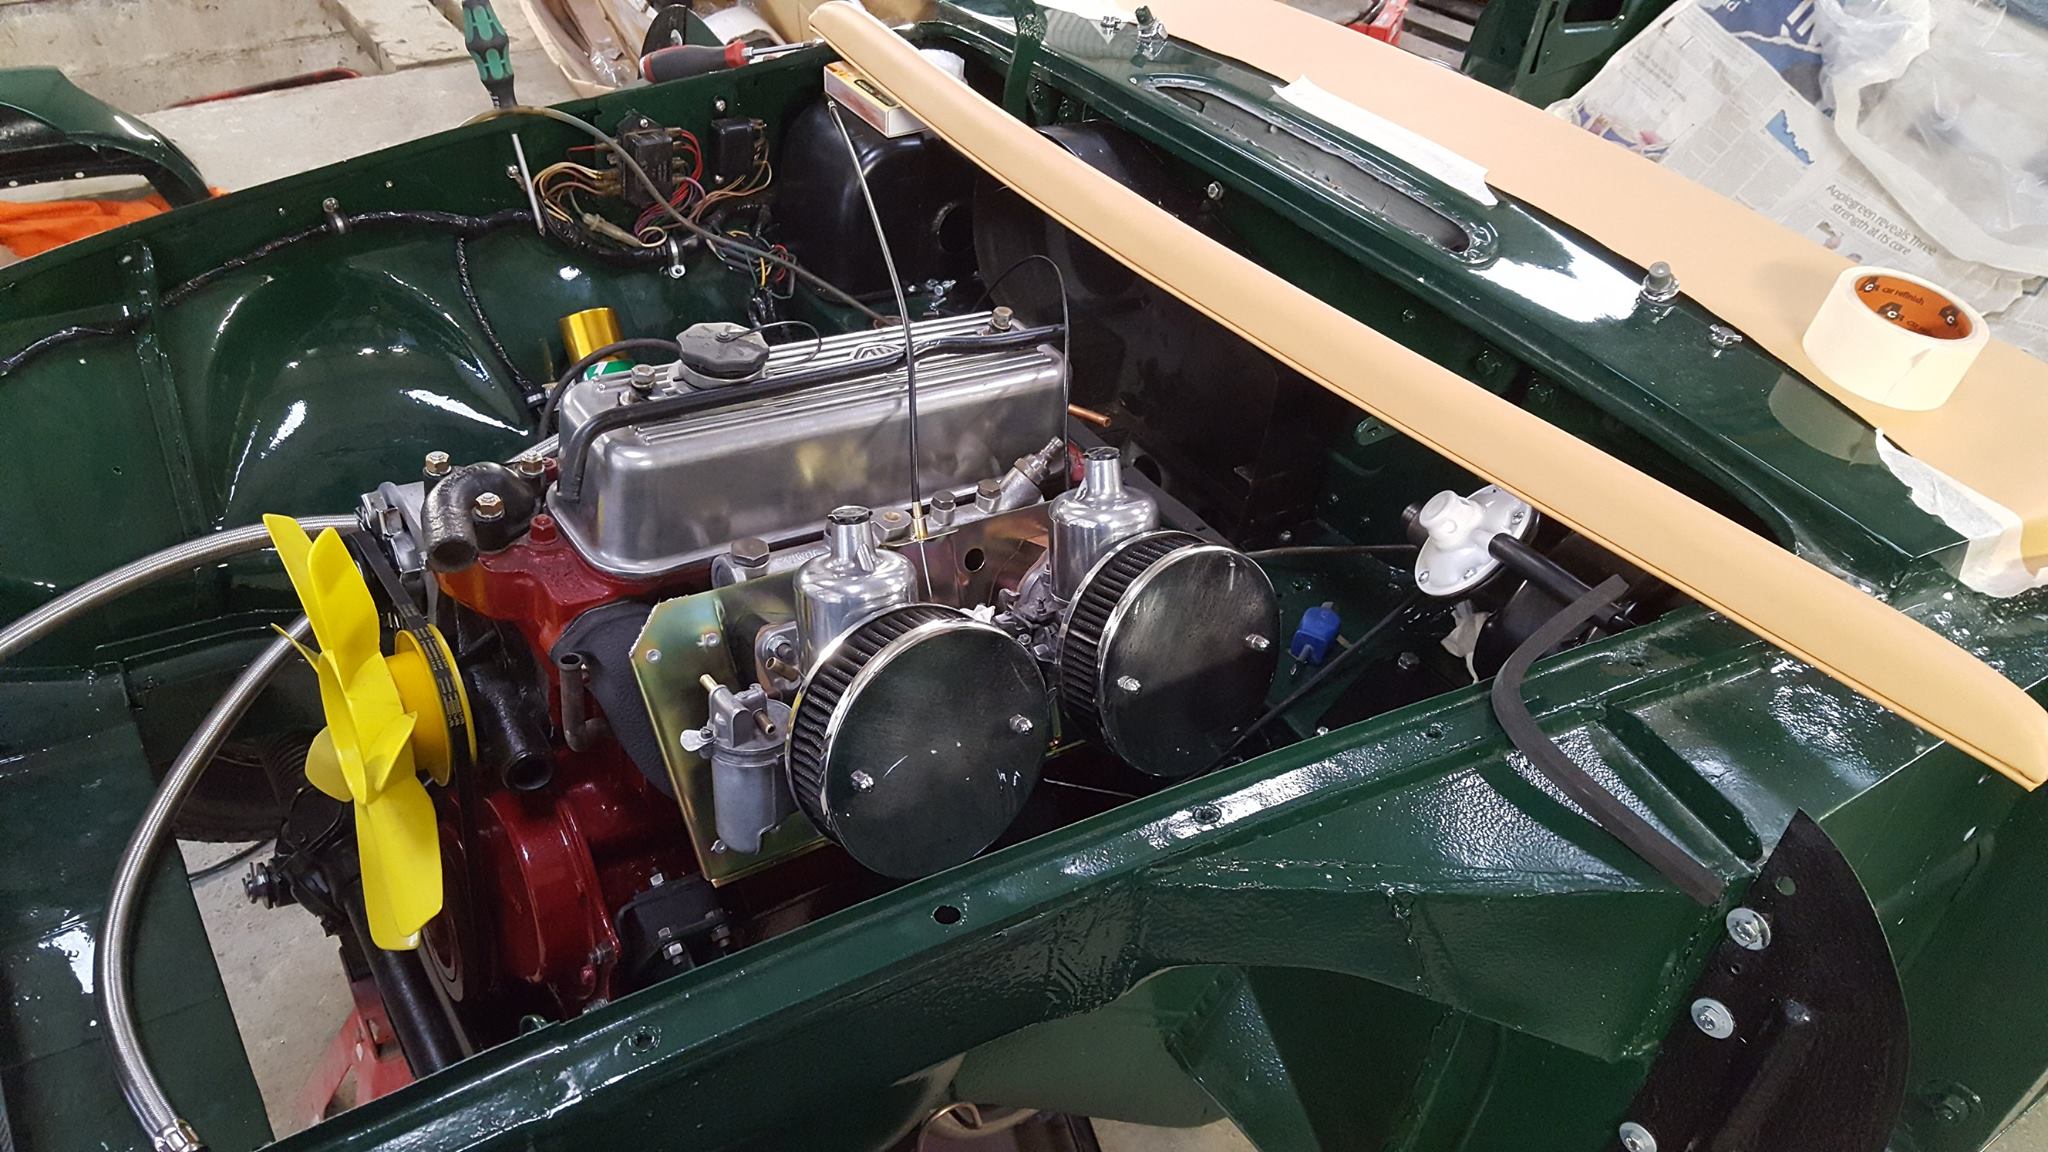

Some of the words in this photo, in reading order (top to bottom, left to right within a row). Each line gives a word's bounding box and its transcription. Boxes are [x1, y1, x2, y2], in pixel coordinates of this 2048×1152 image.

[1826, 184, 1877, 220] Applegreen
[1875, 216, 1911, 241] reveals
[1908, 234, 1937, 256] Three
[1830, 203, 1869, 232] strength
[1866, 227, 1880, 238] at
[1879, 233, 1889, 245] its
[1889, 240, 1911, 255] core
